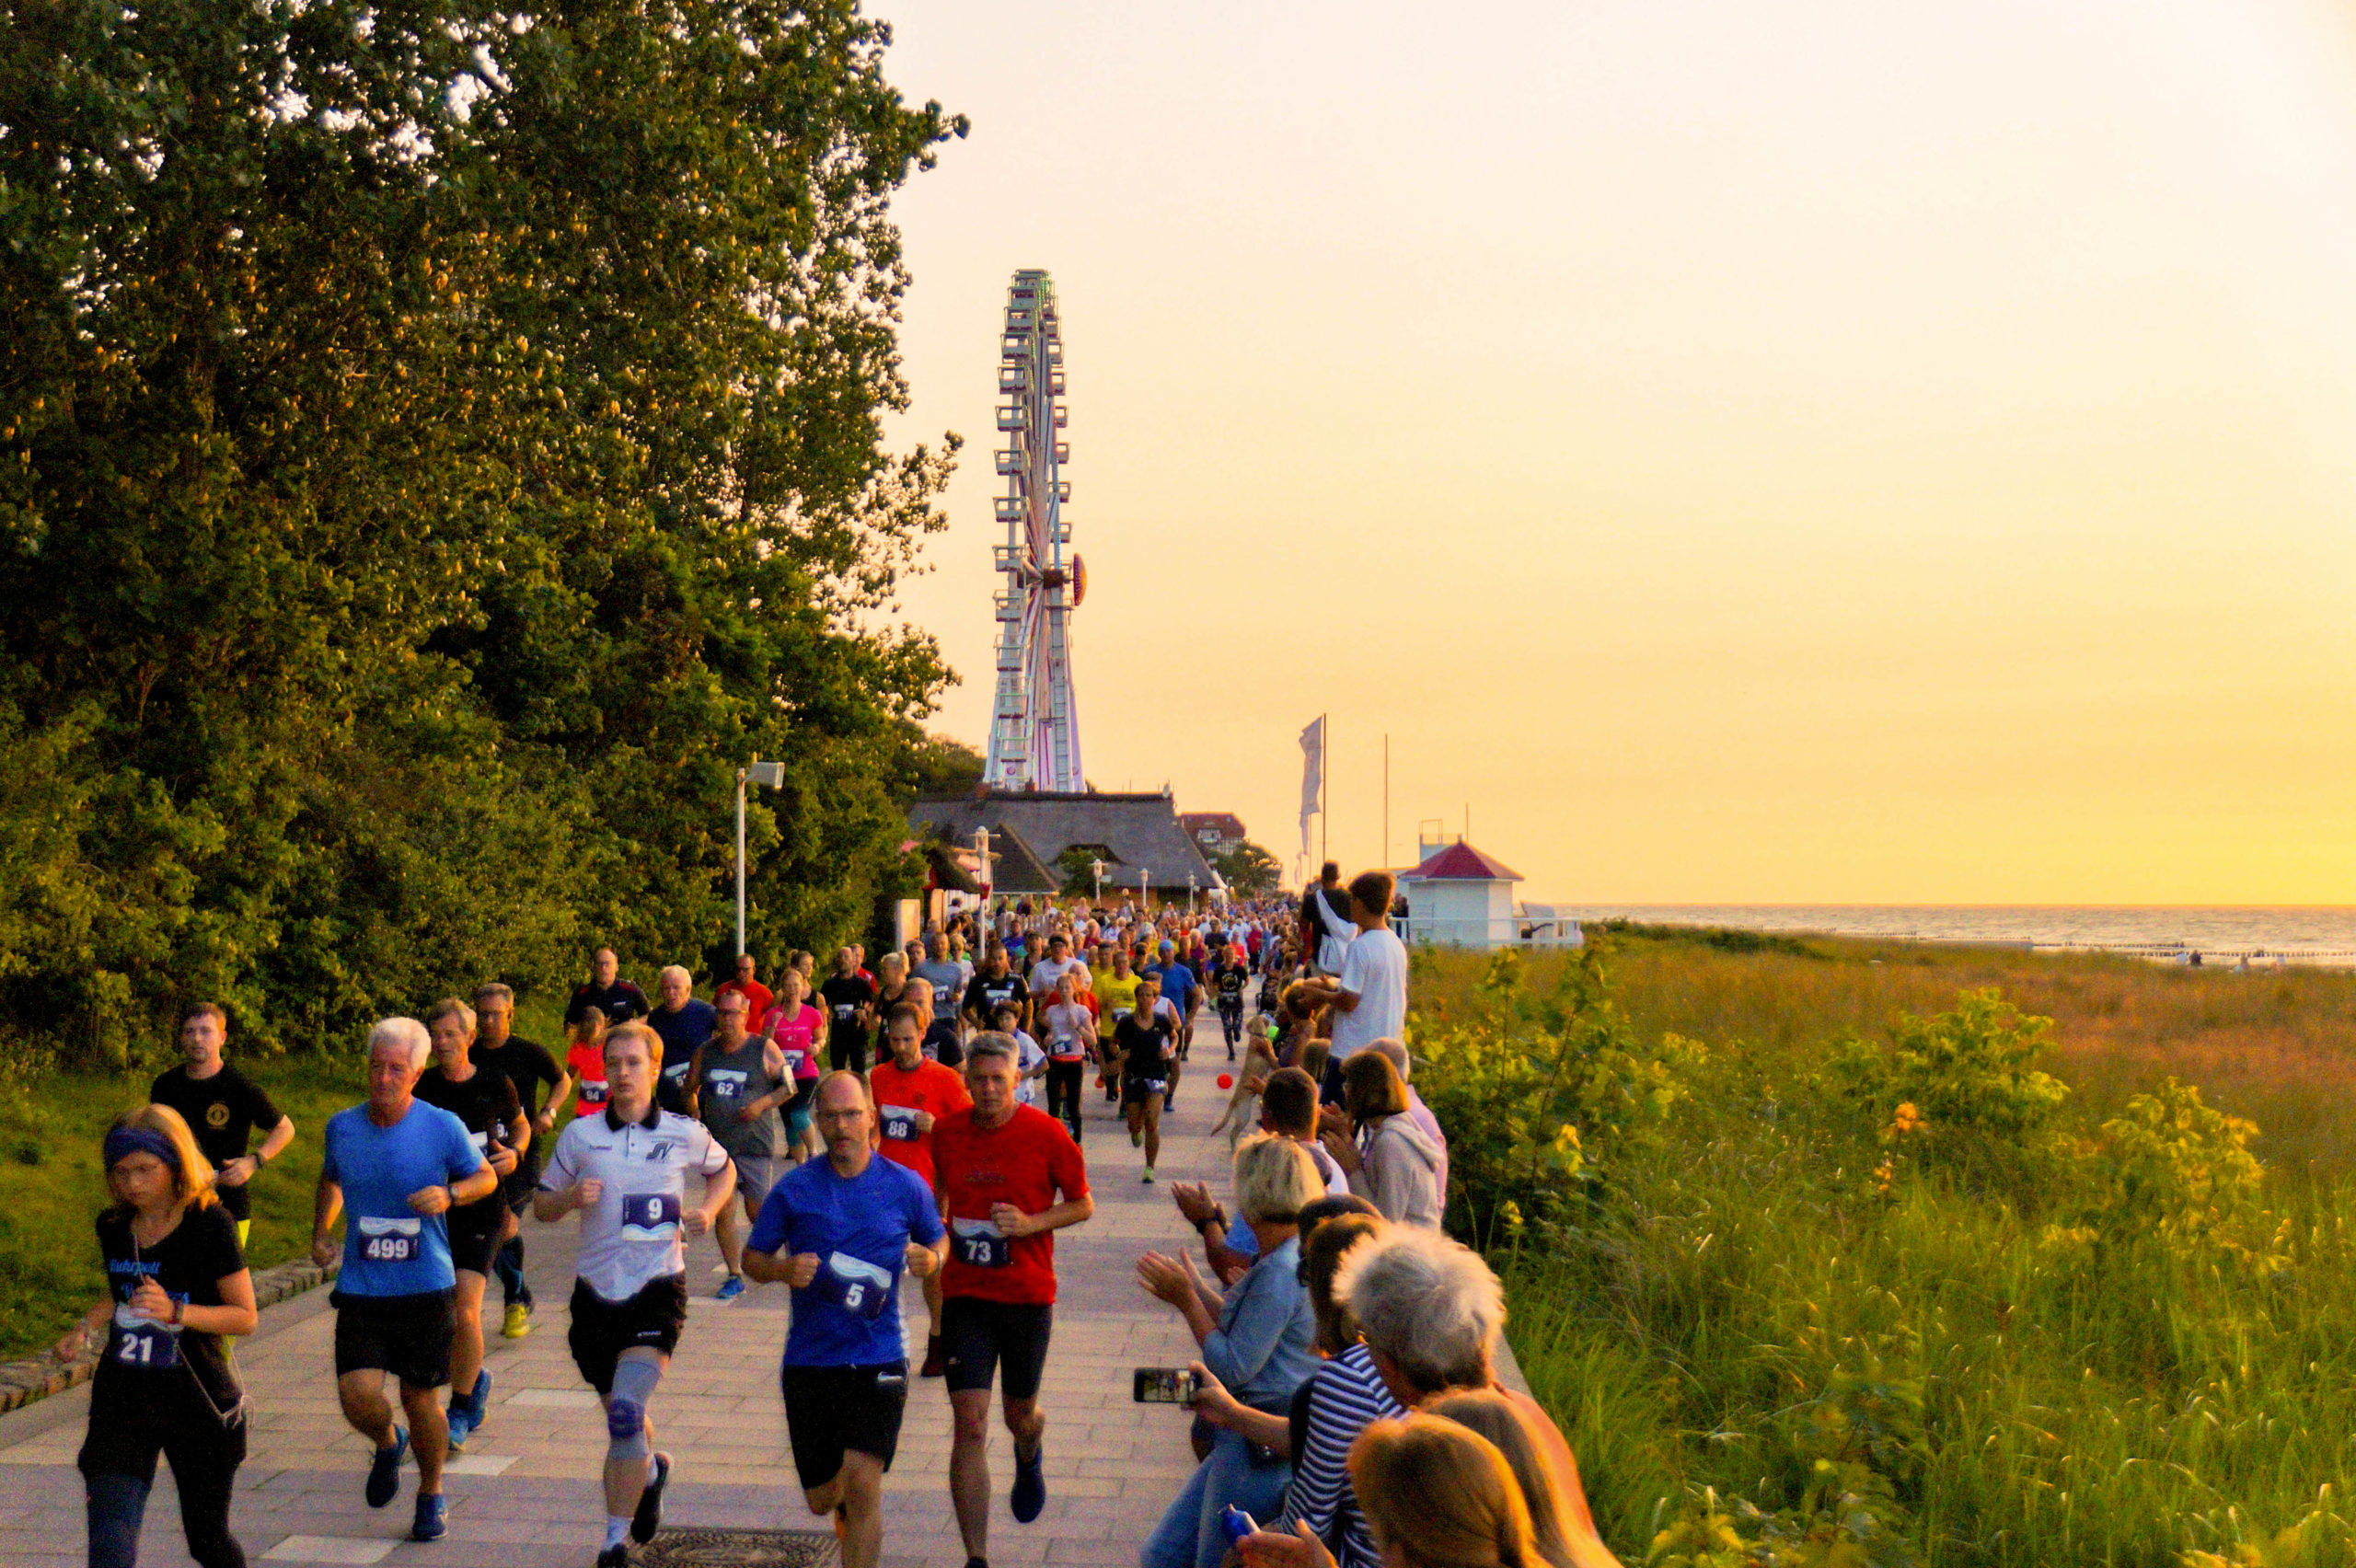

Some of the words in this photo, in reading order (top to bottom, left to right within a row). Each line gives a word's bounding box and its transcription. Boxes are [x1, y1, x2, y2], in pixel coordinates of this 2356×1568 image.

[586, 1090, 599, 1101] 94
[717, 1082, 733, 1096] 62
[888, 1121, 907, 1137] 88
[648, 1197, 663, 1219] 9
[367, 1238, 409, 1258] 499
[965, 1239, 992, 1262] 73
[846, 1283, 865, 1307] 5
[119, 1332, 154, 1363] 21
